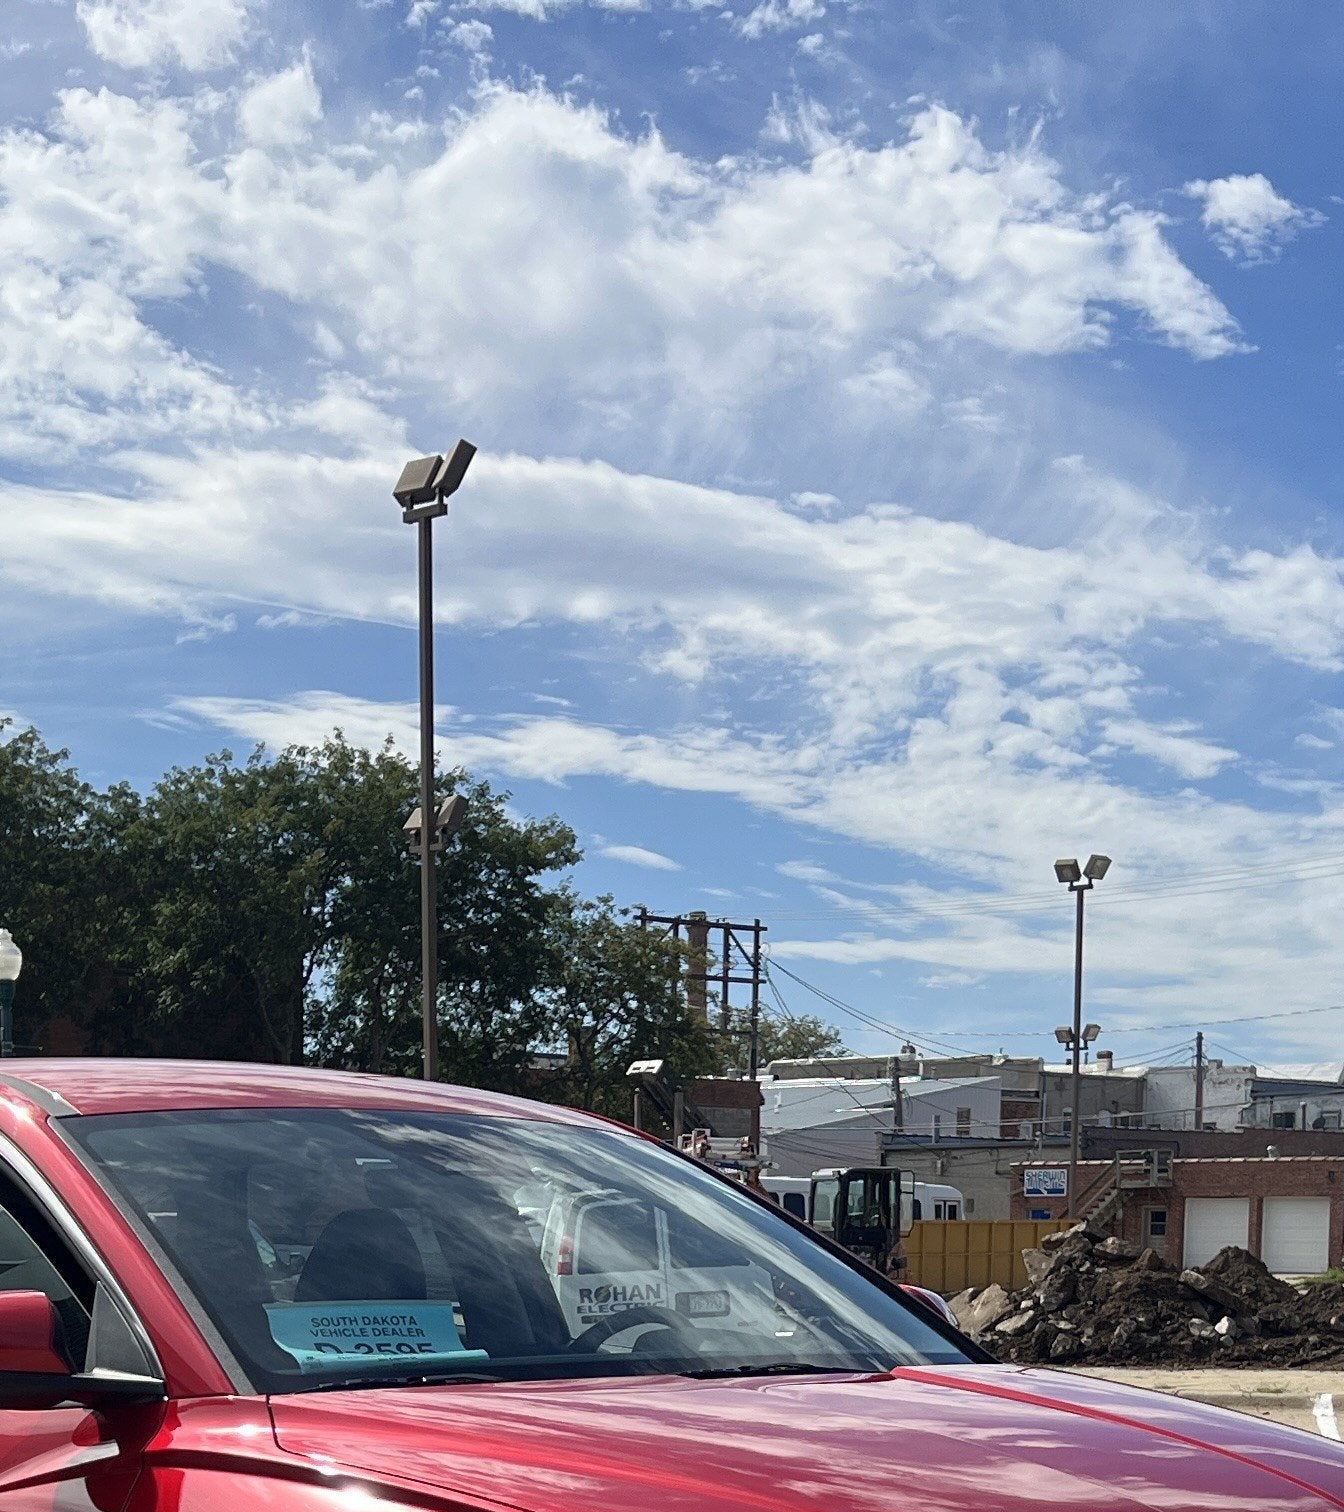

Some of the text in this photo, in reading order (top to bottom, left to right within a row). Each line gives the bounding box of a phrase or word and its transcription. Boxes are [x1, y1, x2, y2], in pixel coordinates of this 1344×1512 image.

[579, 1284, 660, 1304] ROHAN
[311, 1315, 418, 1328] SOUTH DAKOTA
[310, 1328, 425, 1338] VEHICLE DEALER
